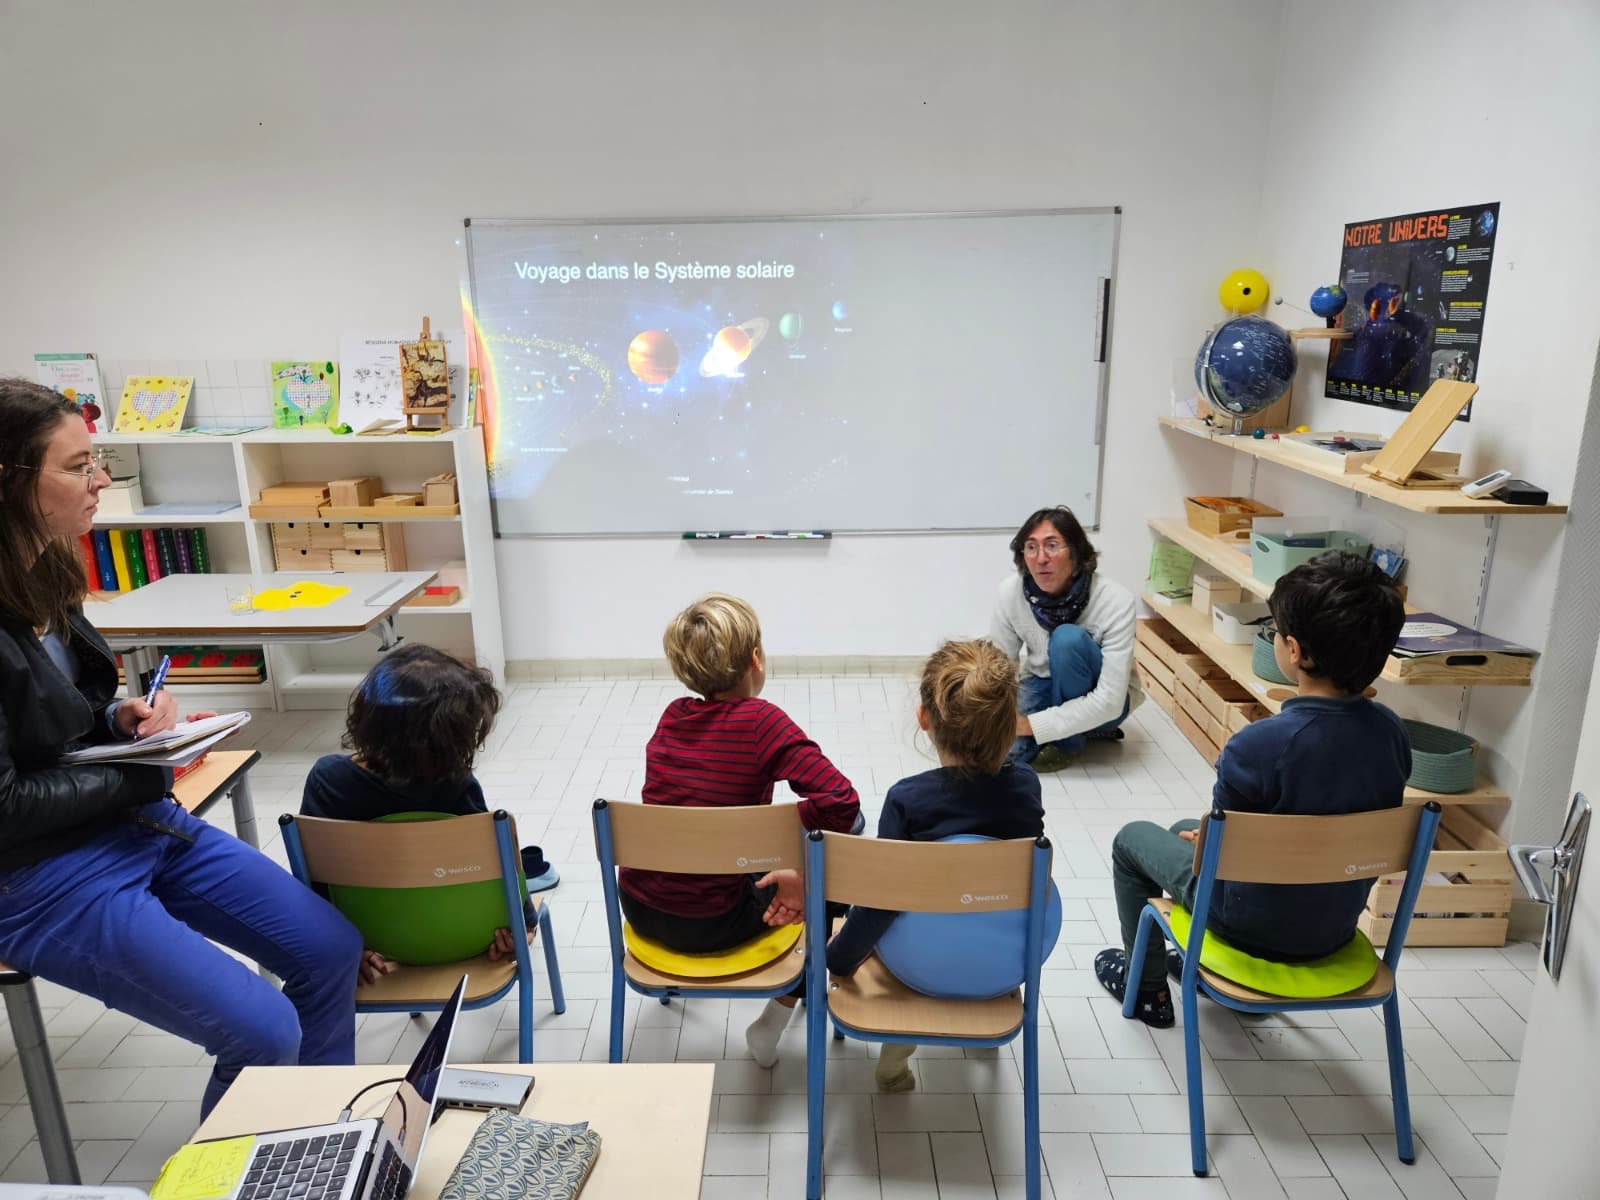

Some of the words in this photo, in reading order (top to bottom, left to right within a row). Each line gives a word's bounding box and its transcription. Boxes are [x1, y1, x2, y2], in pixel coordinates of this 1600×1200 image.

[1344, 223, 1382, 247] NOTRE
[1388, 214, 1449, 242] UNIVERS
[514, 262, 581, 283] Voyage
[586, 262, 629, 280] dans
[634, 262, 649, 280] le
[654, 261, 731, 283] Système
[736, 261, 795, 280] solaire
